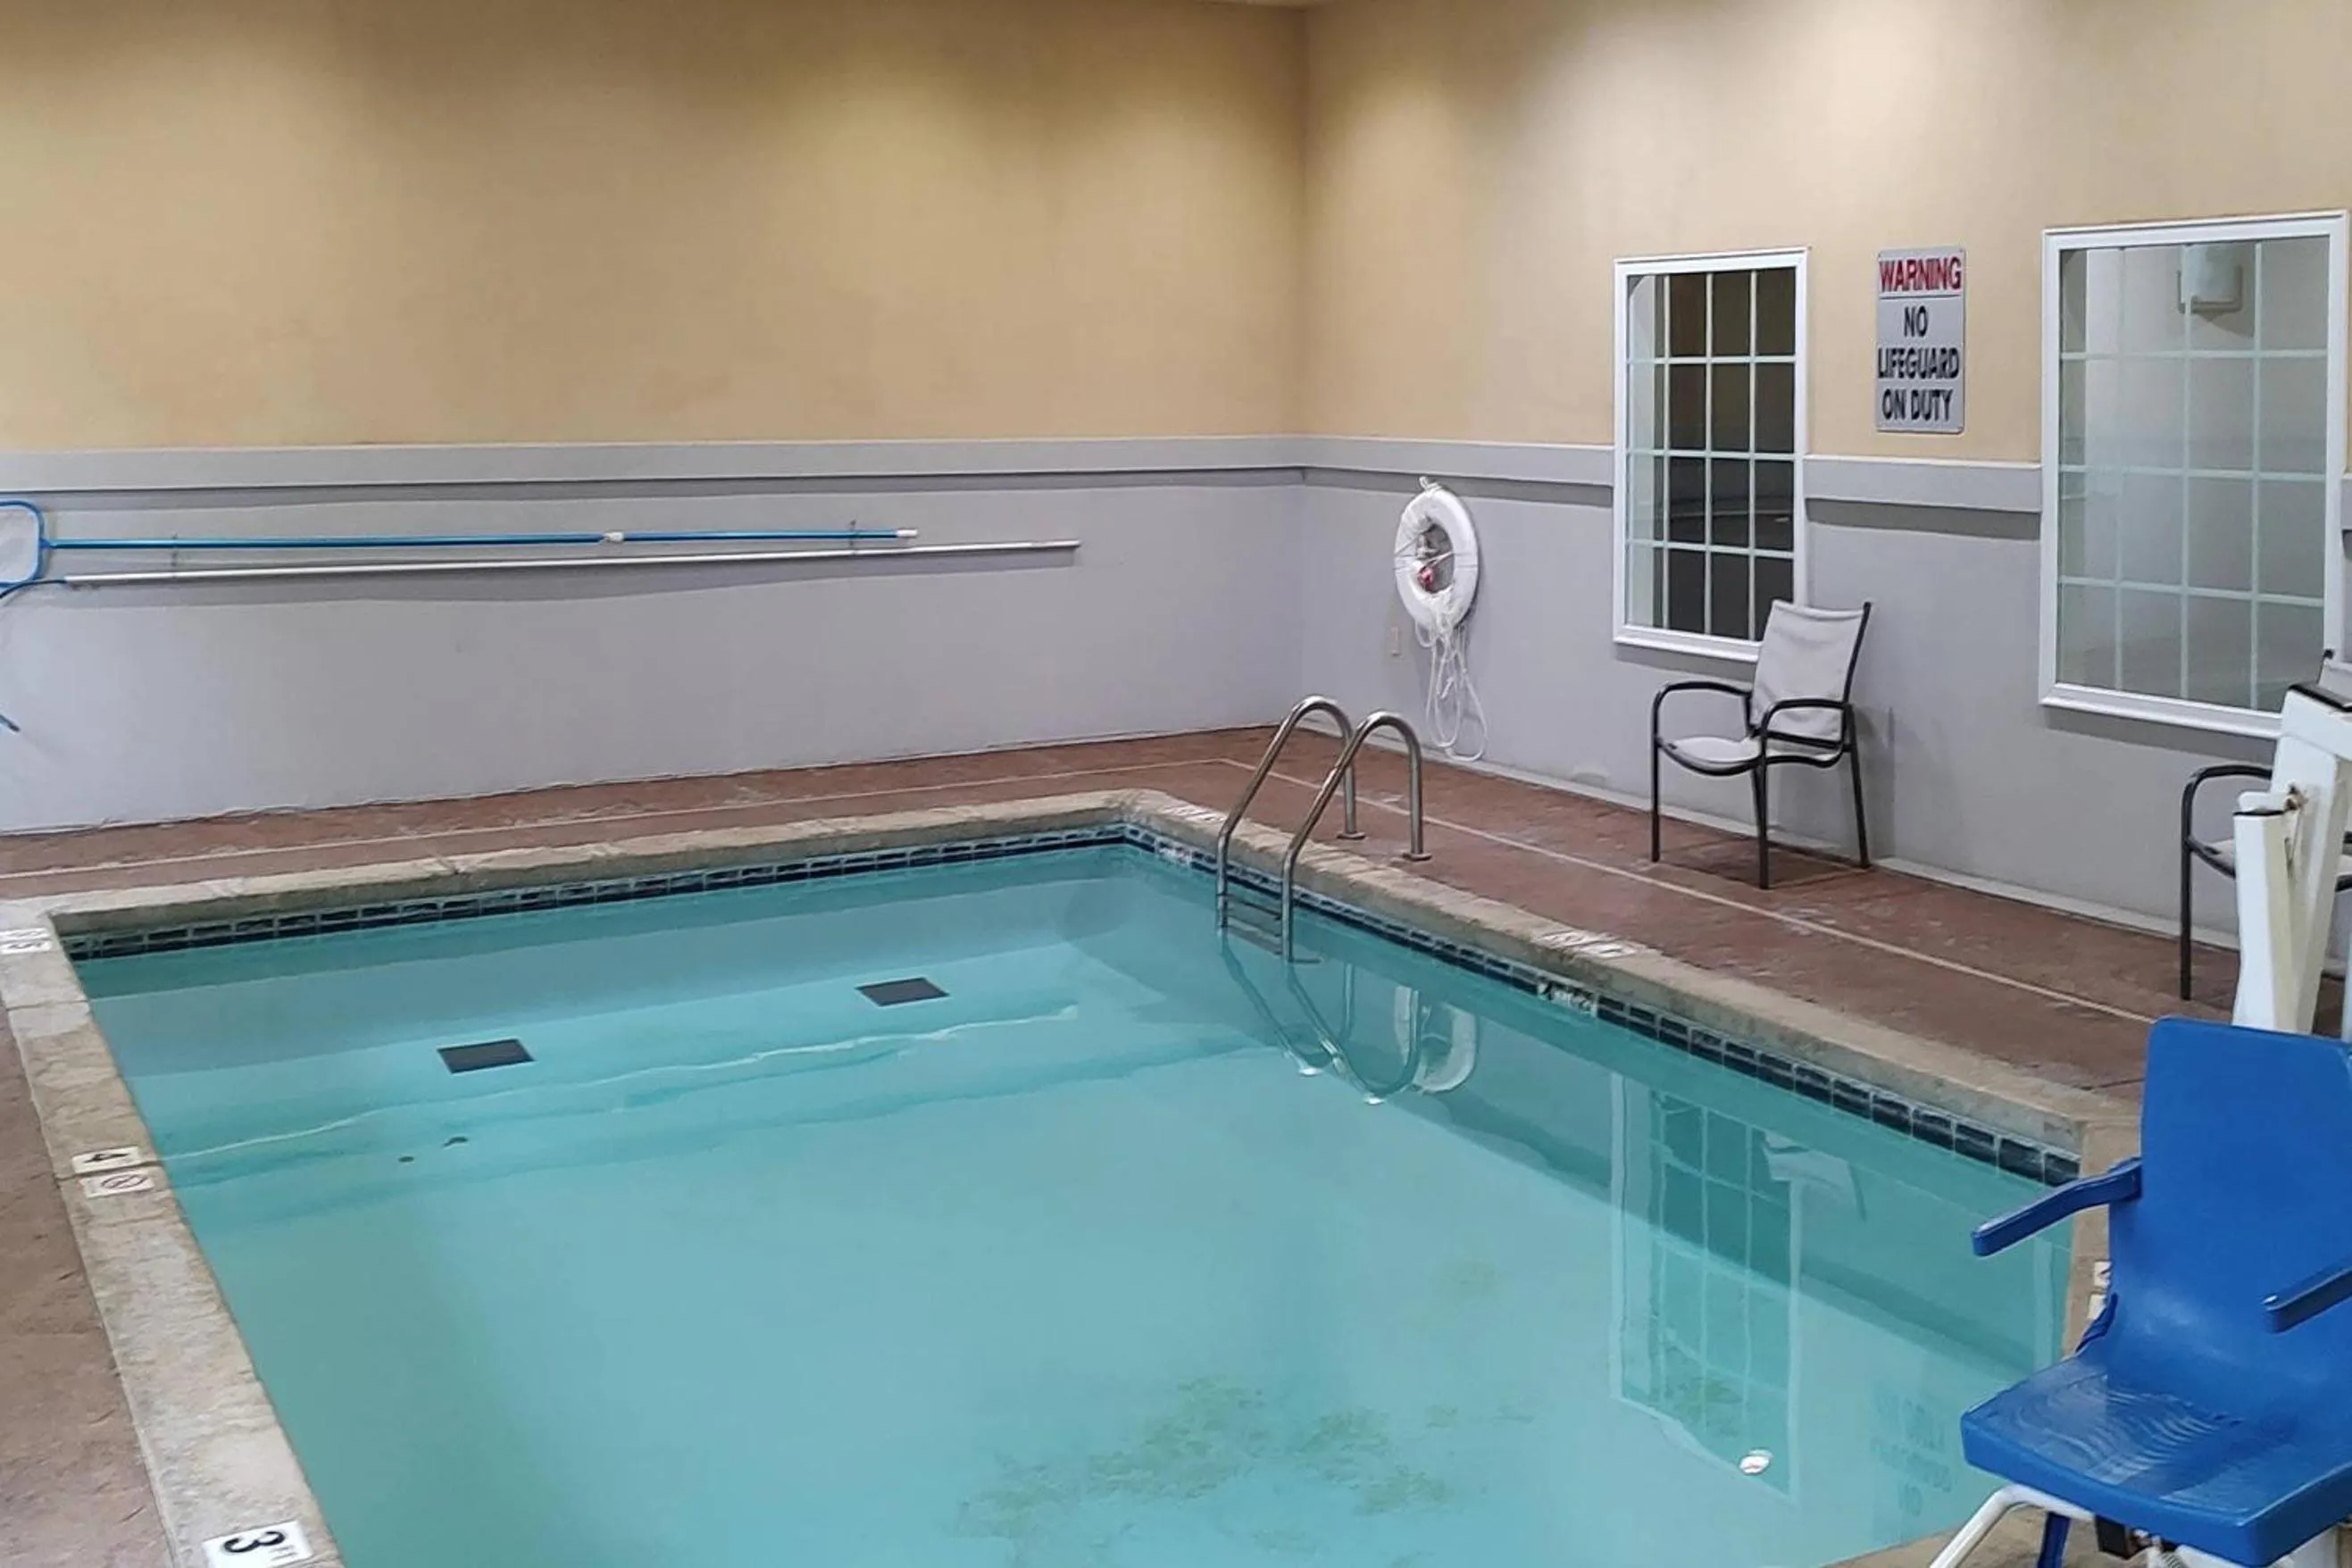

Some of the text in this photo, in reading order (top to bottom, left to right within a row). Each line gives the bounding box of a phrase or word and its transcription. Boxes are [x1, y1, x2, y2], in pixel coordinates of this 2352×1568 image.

[1879, 256, 1961, 292] WARNING
[1904, 305, 1929, 338] NO
[1878, 346, 1960, 379] LIFEGUARD
[1881, 388, 1954, 421] ON DUTY
[223, 1530, 286, 1554] 3
